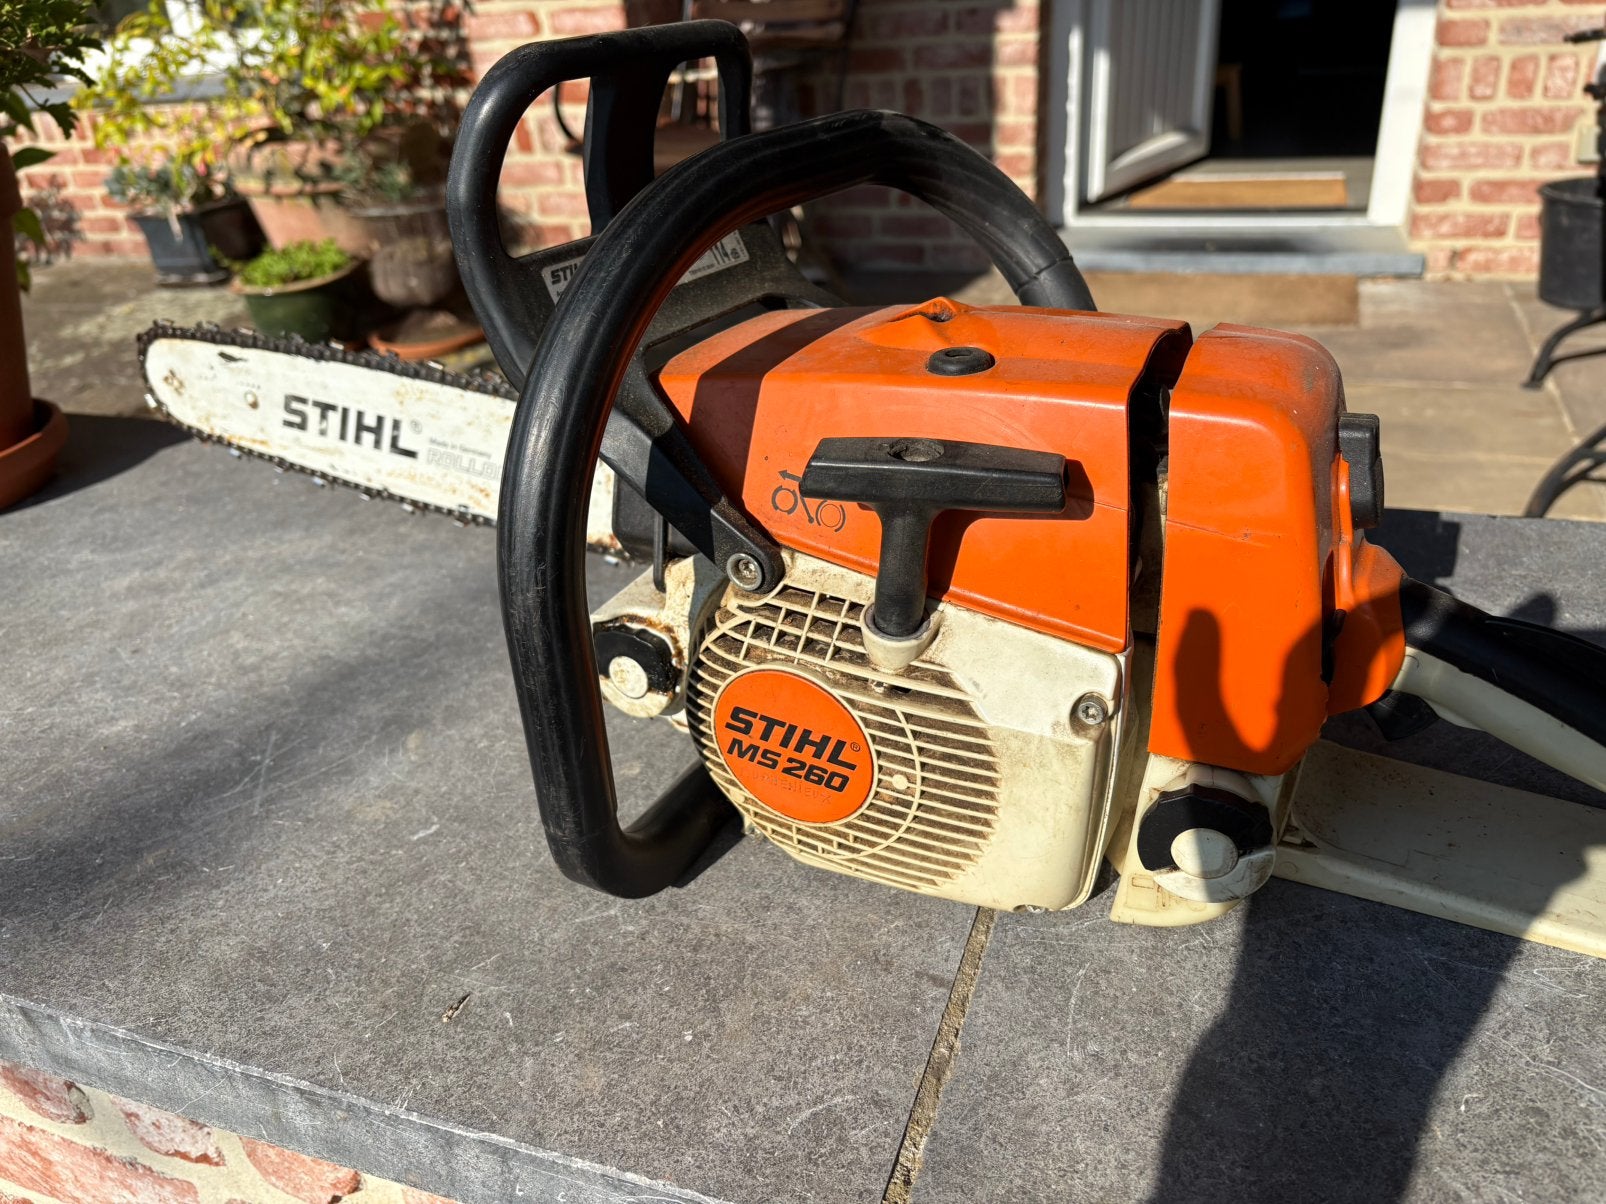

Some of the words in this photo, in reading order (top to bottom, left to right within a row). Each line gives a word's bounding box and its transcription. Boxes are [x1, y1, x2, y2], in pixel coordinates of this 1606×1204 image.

[283, 393, 418, 459] STIHL
[427, 447, 502, 481] ROLLO
[725, 706, 857, 771] STIHL
[727, 737, 782, 770] MS
[781, 757, 850, 793] 260
